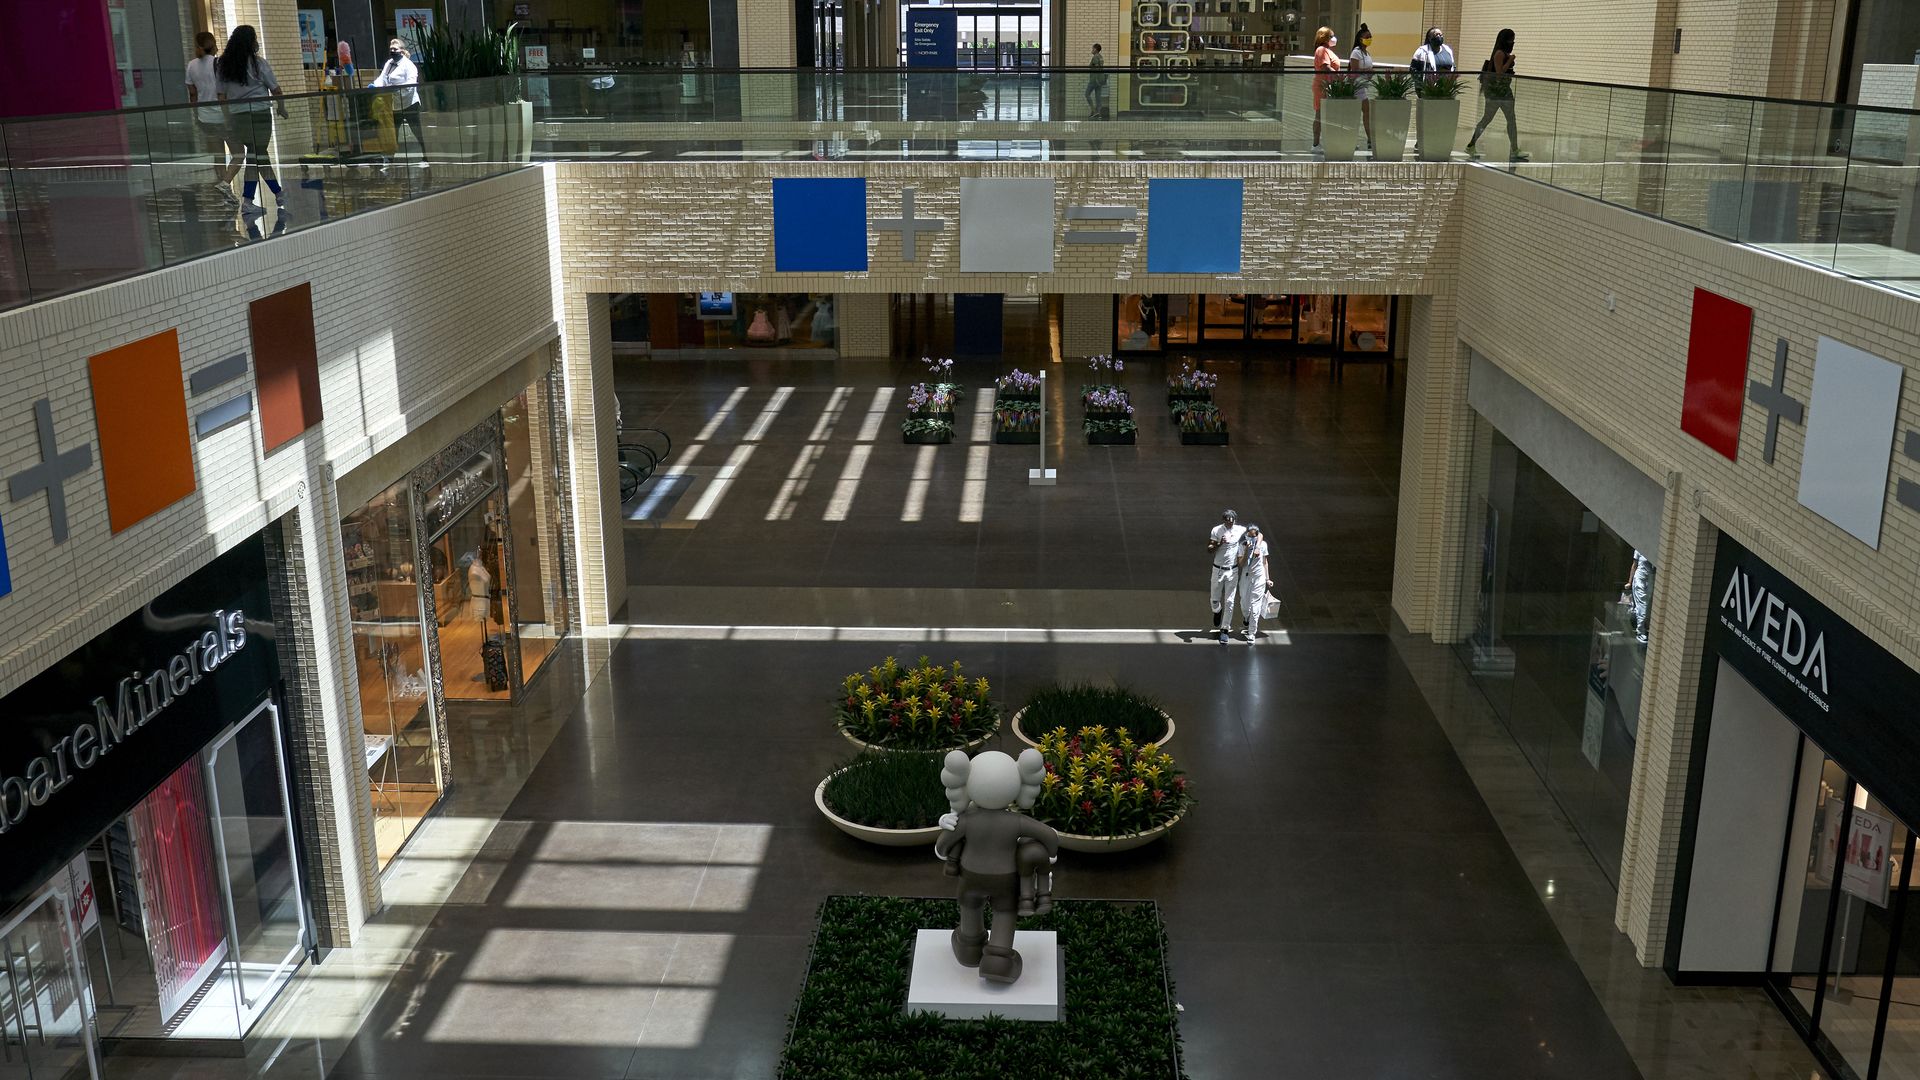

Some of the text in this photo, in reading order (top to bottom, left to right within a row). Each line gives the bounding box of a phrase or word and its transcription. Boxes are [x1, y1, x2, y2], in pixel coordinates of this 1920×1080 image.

[402, 16, 427, 28] FRE
[1720, 566, 1828, 694] AVEDA
[1720, 615, 1829, 713] THE ART AND SCIENCE OF PURE FLOWER AND PLANT ESSENCES
[0, 610, 247, 834] bareMinerals
